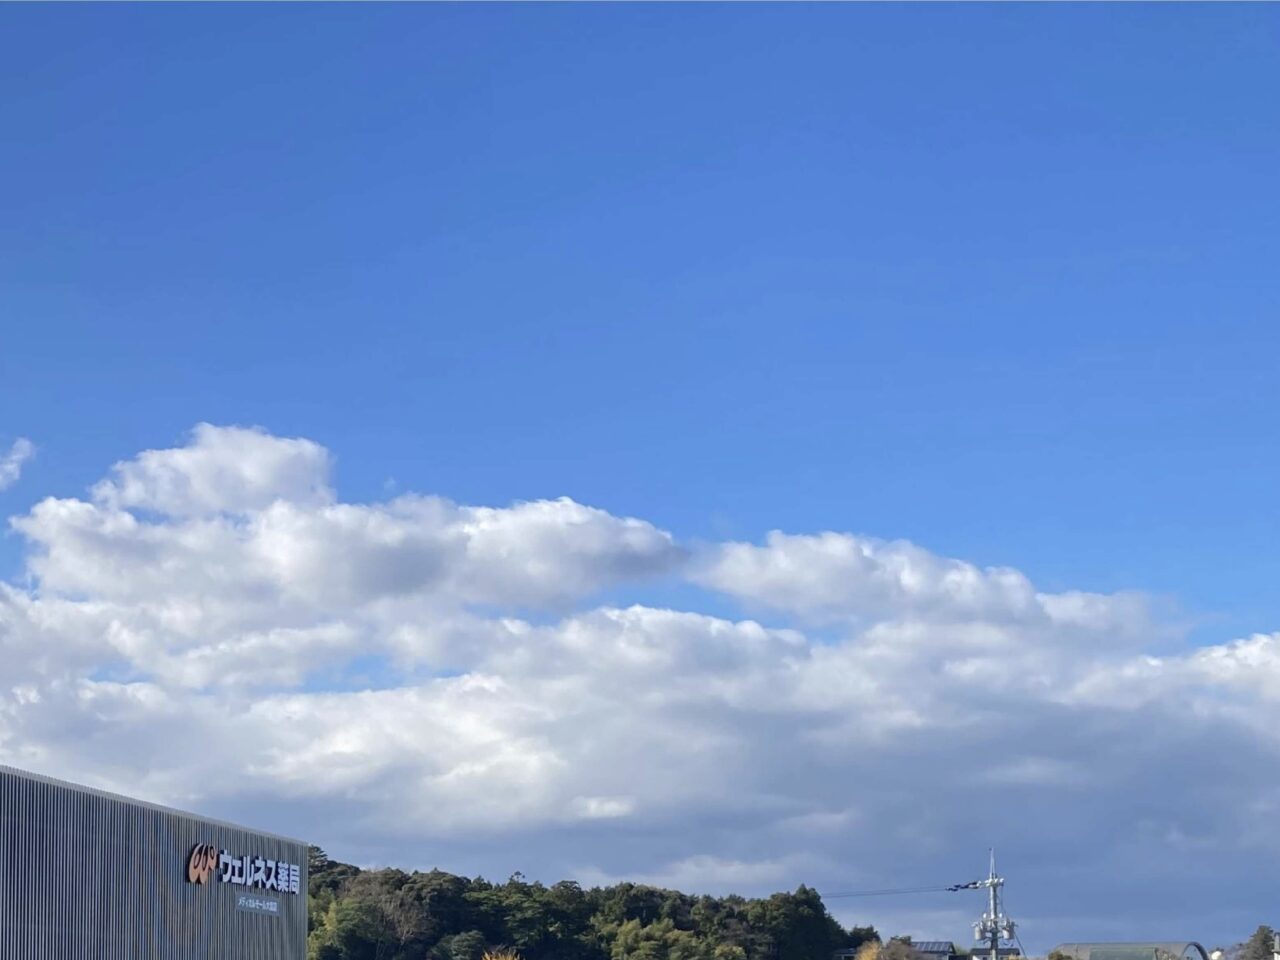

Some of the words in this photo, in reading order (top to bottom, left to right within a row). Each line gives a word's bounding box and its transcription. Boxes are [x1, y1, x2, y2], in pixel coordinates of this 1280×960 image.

[219, 849, 300, 895] ウェルネス薬局
